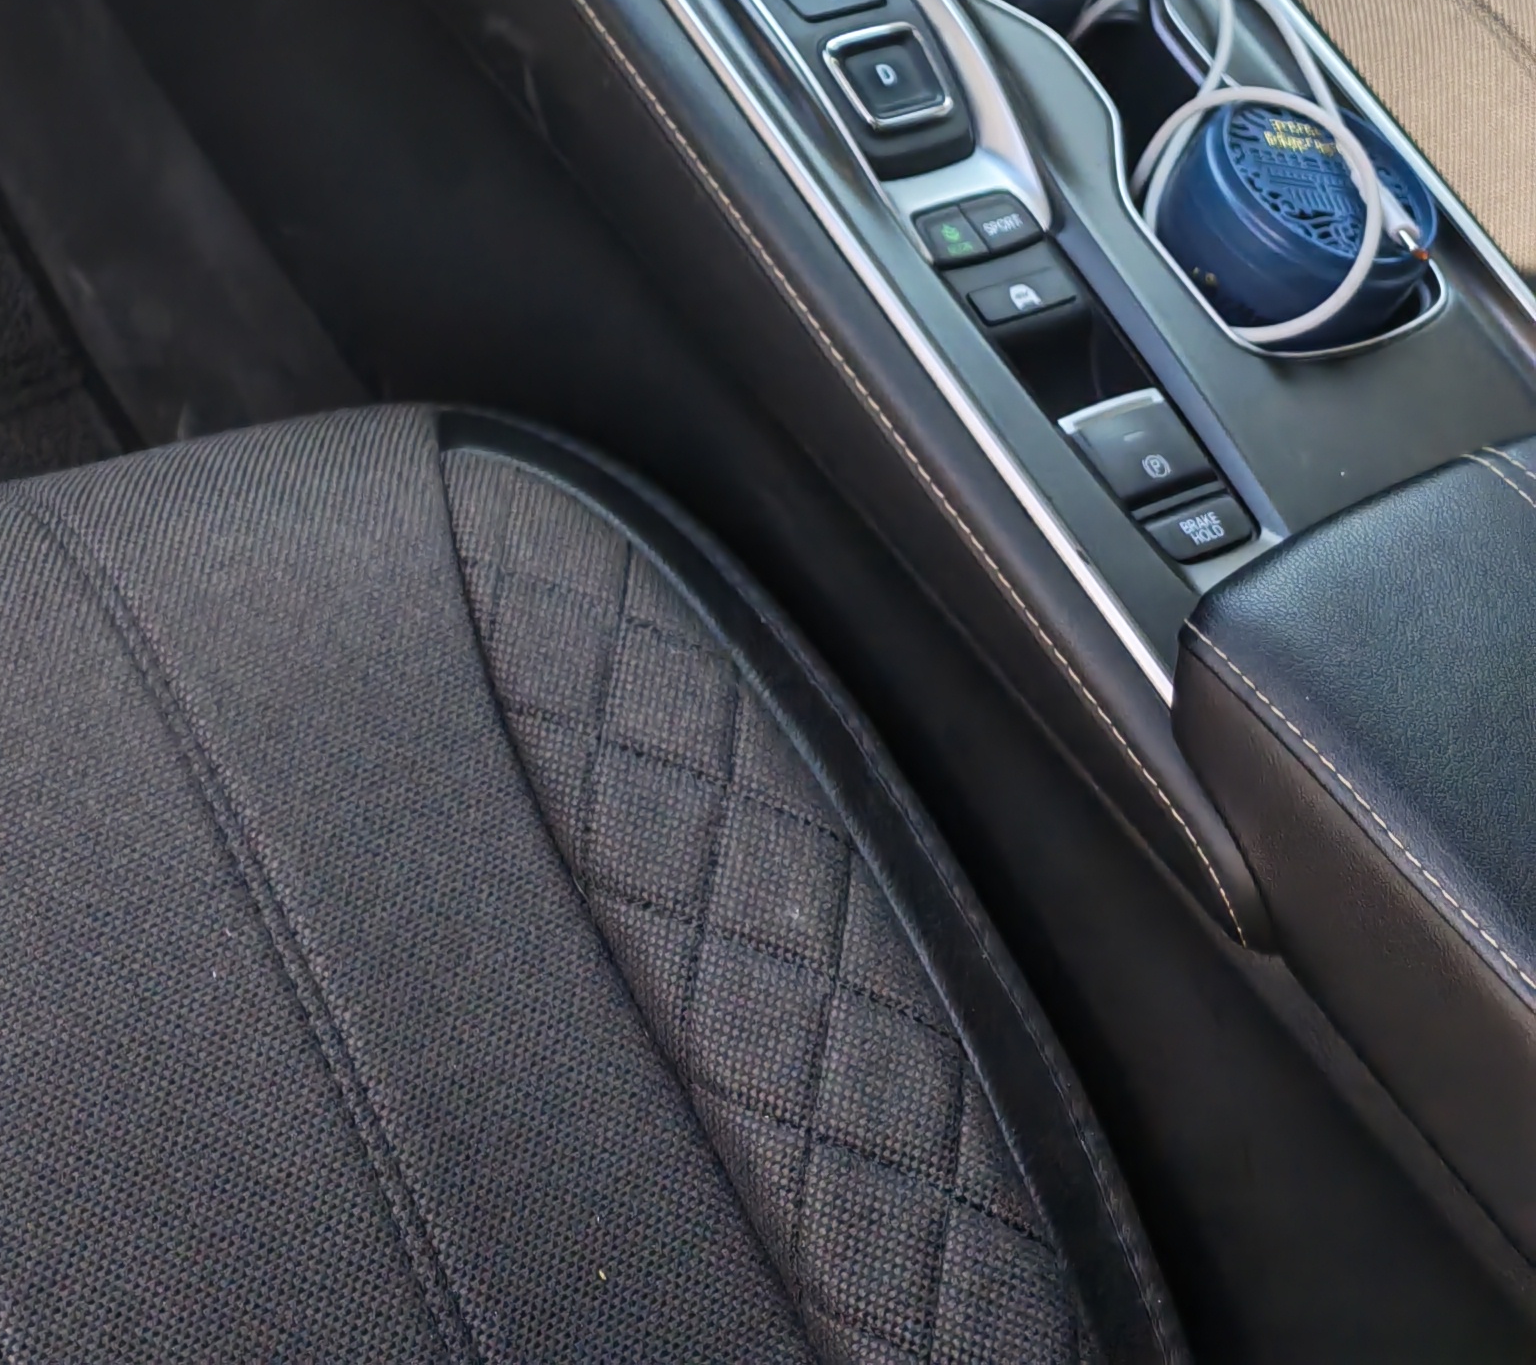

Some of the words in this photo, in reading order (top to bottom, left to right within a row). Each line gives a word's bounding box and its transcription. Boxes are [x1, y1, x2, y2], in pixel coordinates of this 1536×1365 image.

[875, 63, 898, 86] D
[1179, 511, 1221, 535] BRAKE
[1190, 524, 1225, 546] HOLD
